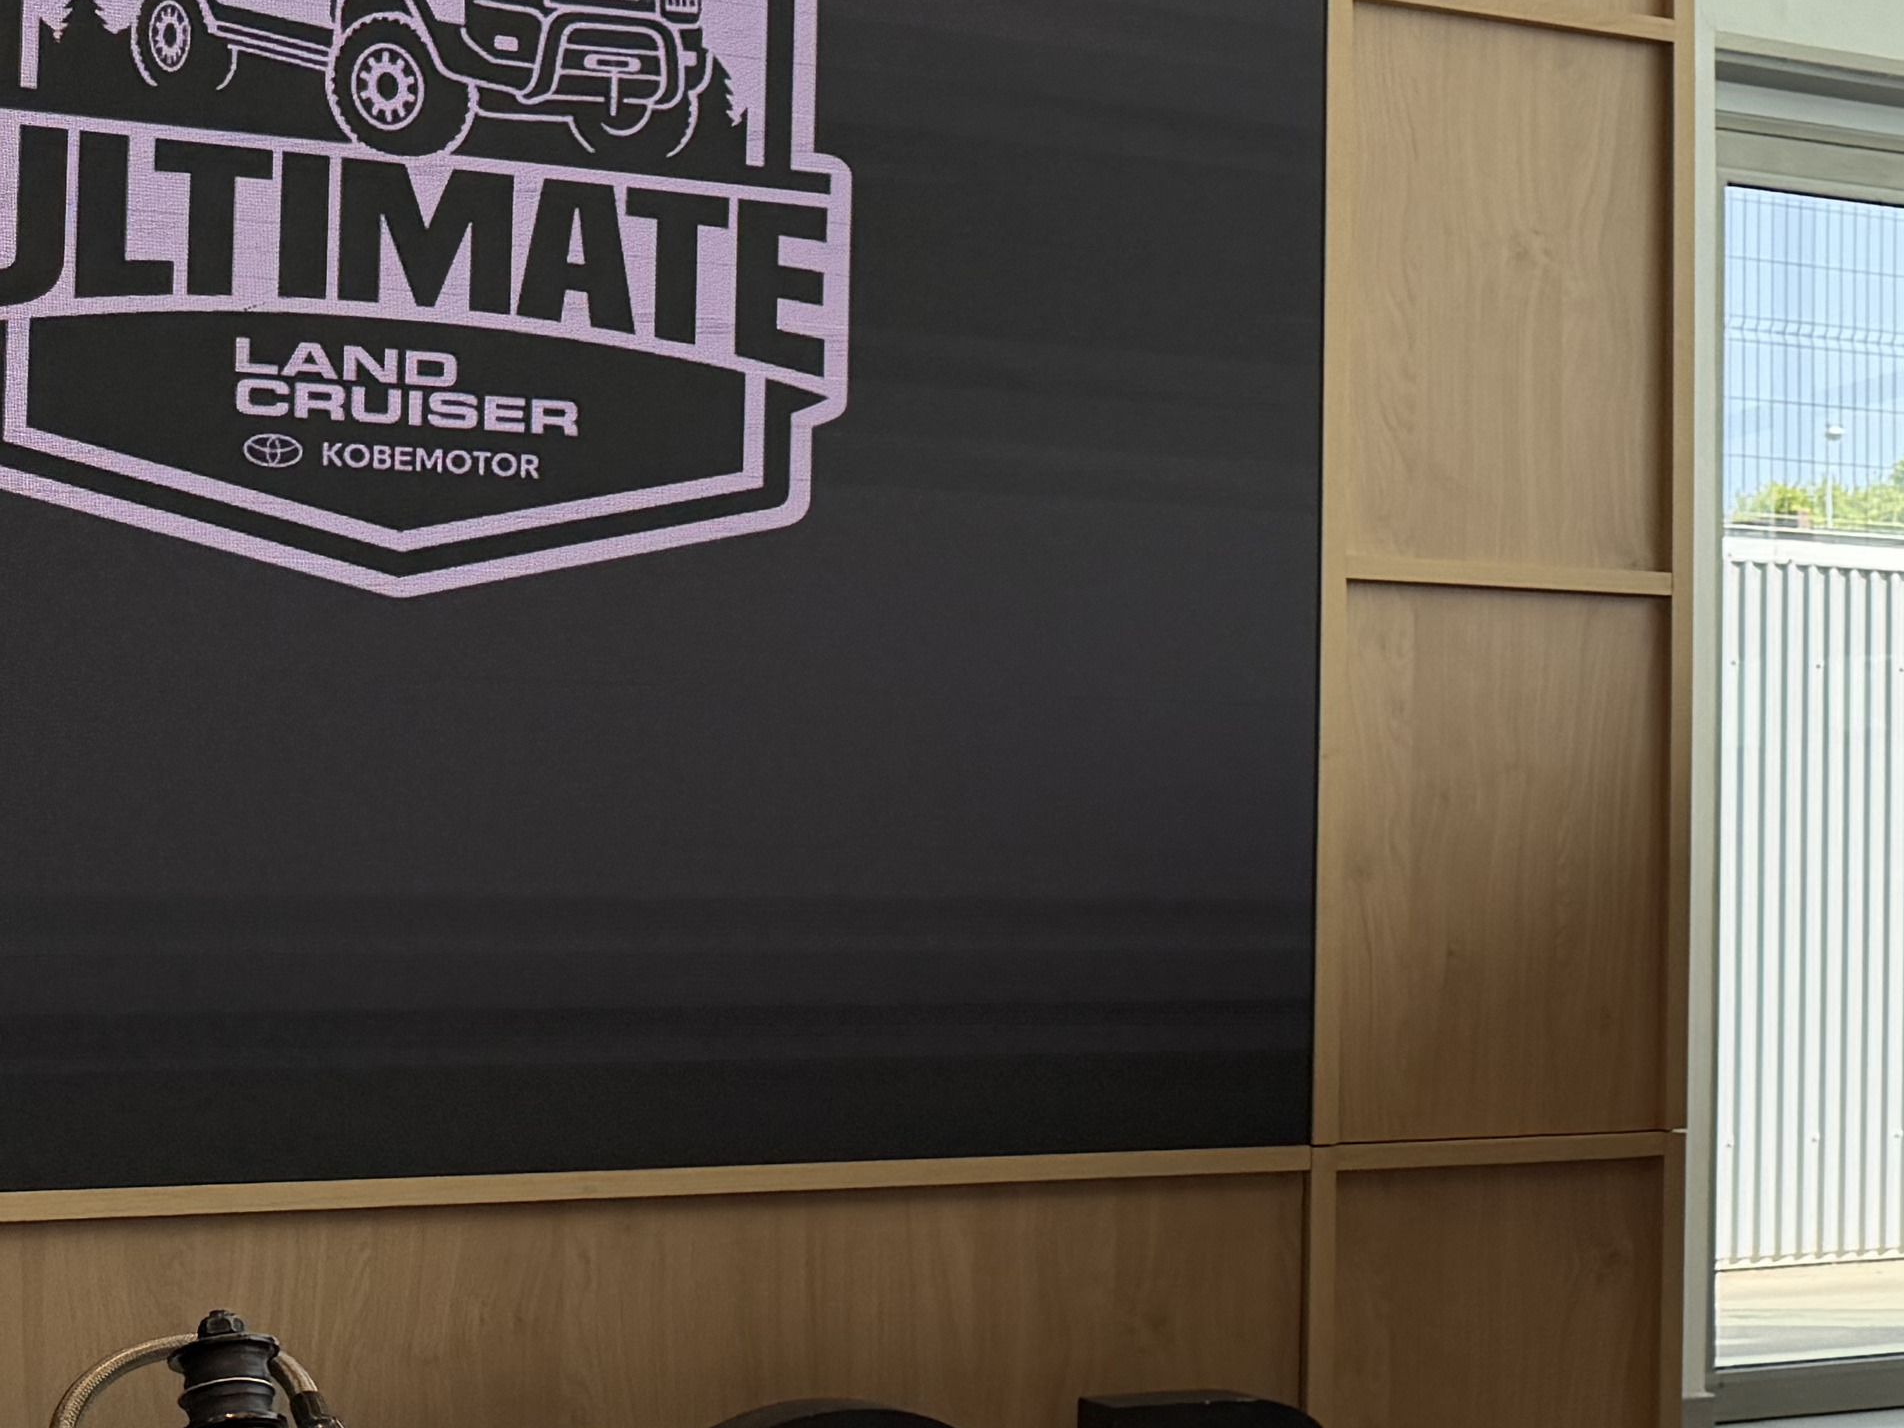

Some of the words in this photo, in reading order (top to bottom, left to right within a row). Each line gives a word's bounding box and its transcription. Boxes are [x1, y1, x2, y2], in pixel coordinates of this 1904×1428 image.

[235, 336, 458, 387] LAND
[235, 377, 579, 437] CRUISER
[321, 440, 541, 480] KOBEMOTOR
